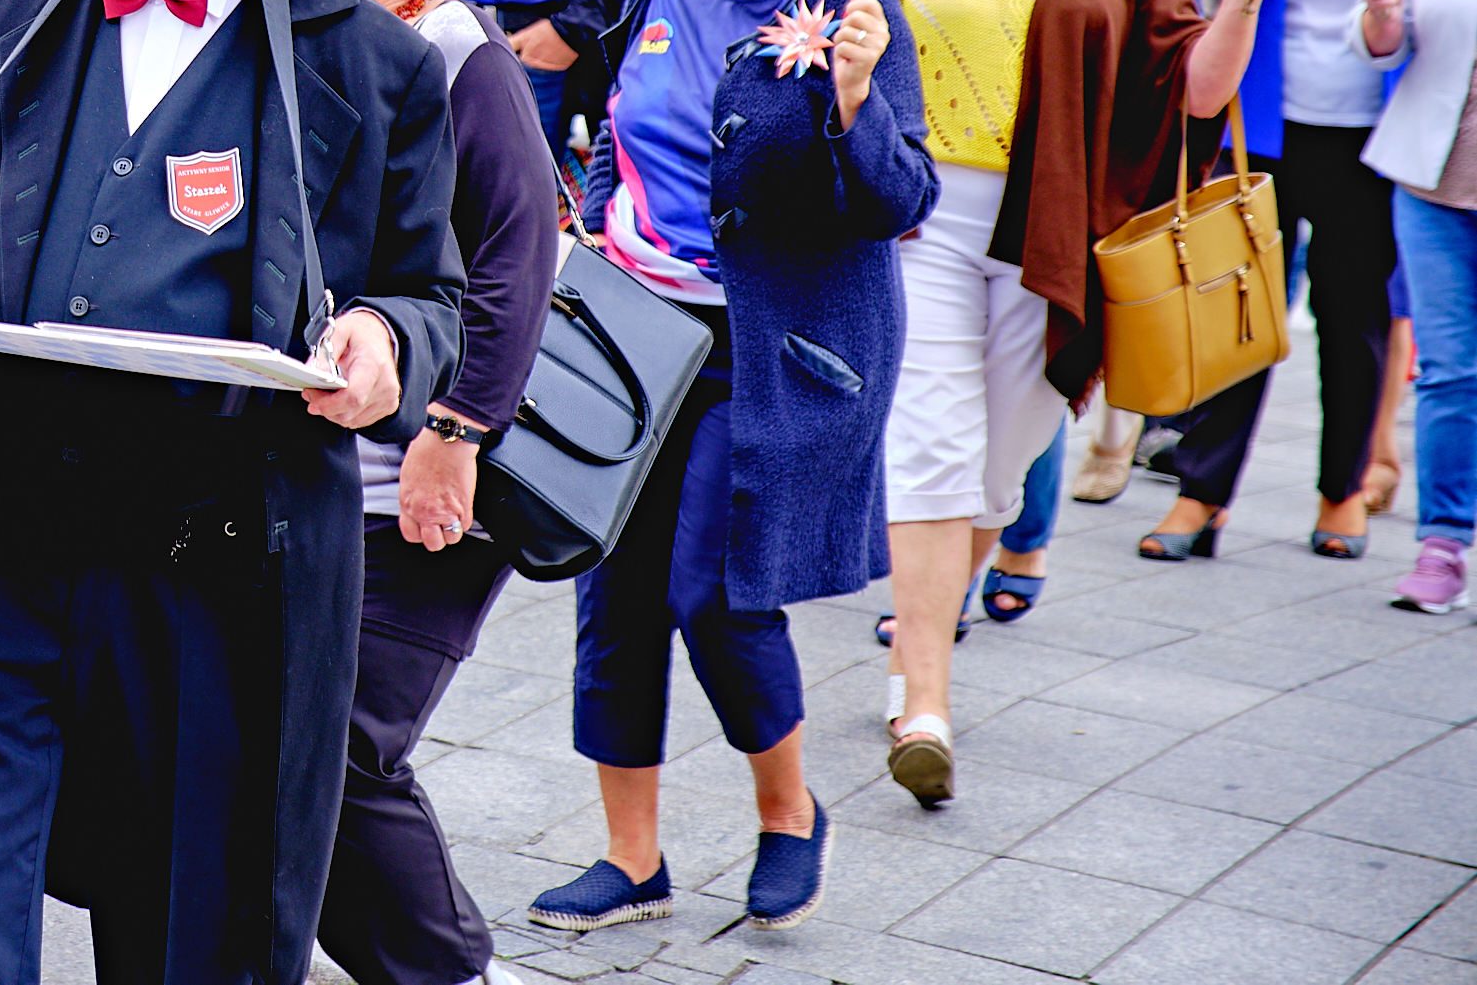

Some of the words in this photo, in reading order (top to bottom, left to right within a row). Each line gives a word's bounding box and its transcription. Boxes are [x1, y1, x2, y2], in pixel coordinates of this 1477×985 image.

[177, 167, 207, 177] AKTYWNY
[208, 165, 231, 174] SENIOR
[184, 182, 228, 198] Staszek
[182, 205, 202, 216] STARE
[204, 201, 231, 217] GLIWICE
